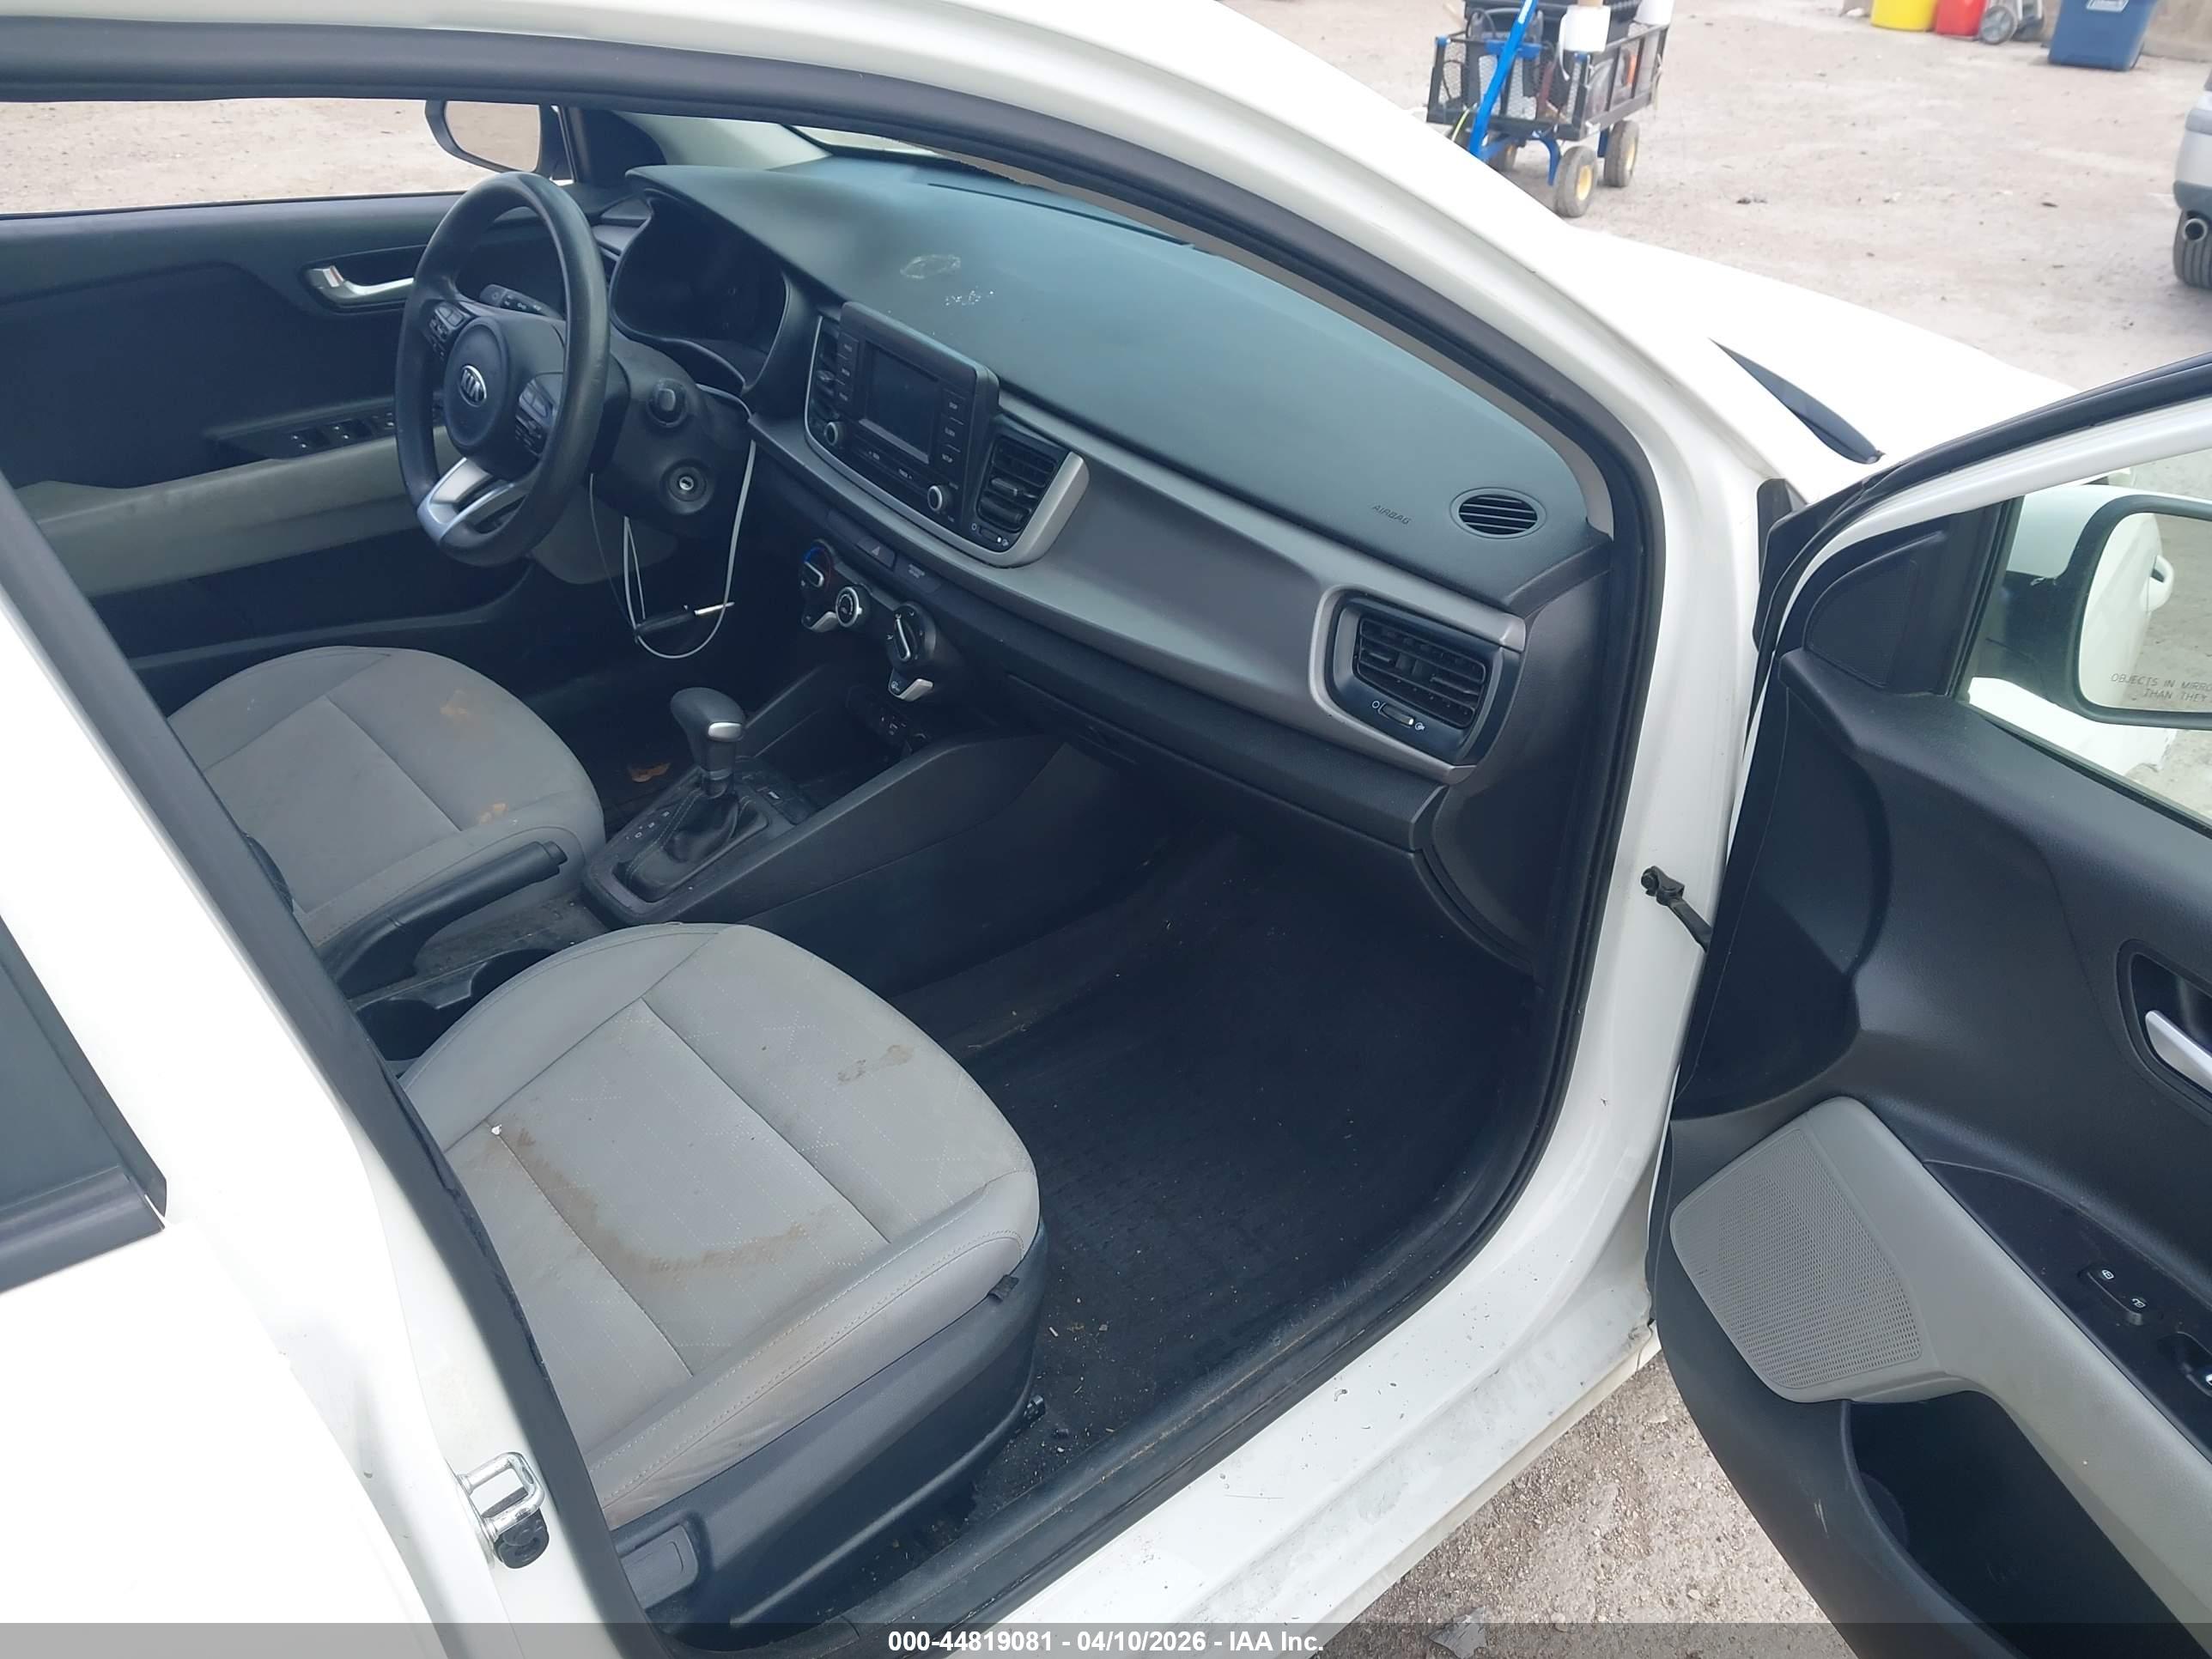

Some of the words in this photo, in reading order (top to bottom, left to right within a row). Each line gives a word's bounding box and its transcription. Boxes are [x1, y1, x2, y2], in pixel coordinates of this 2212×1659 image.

[460, 369, 481, 402] KIA
[1371, 505, 1412, 525] AIRBAG
[2110, 673, 2158, 686] OBJECTS
[2163, 679, 2175, 688] IN
[2143, 689, 2172, 700] THAN
[2181, 692, 2208, 702] THEY
